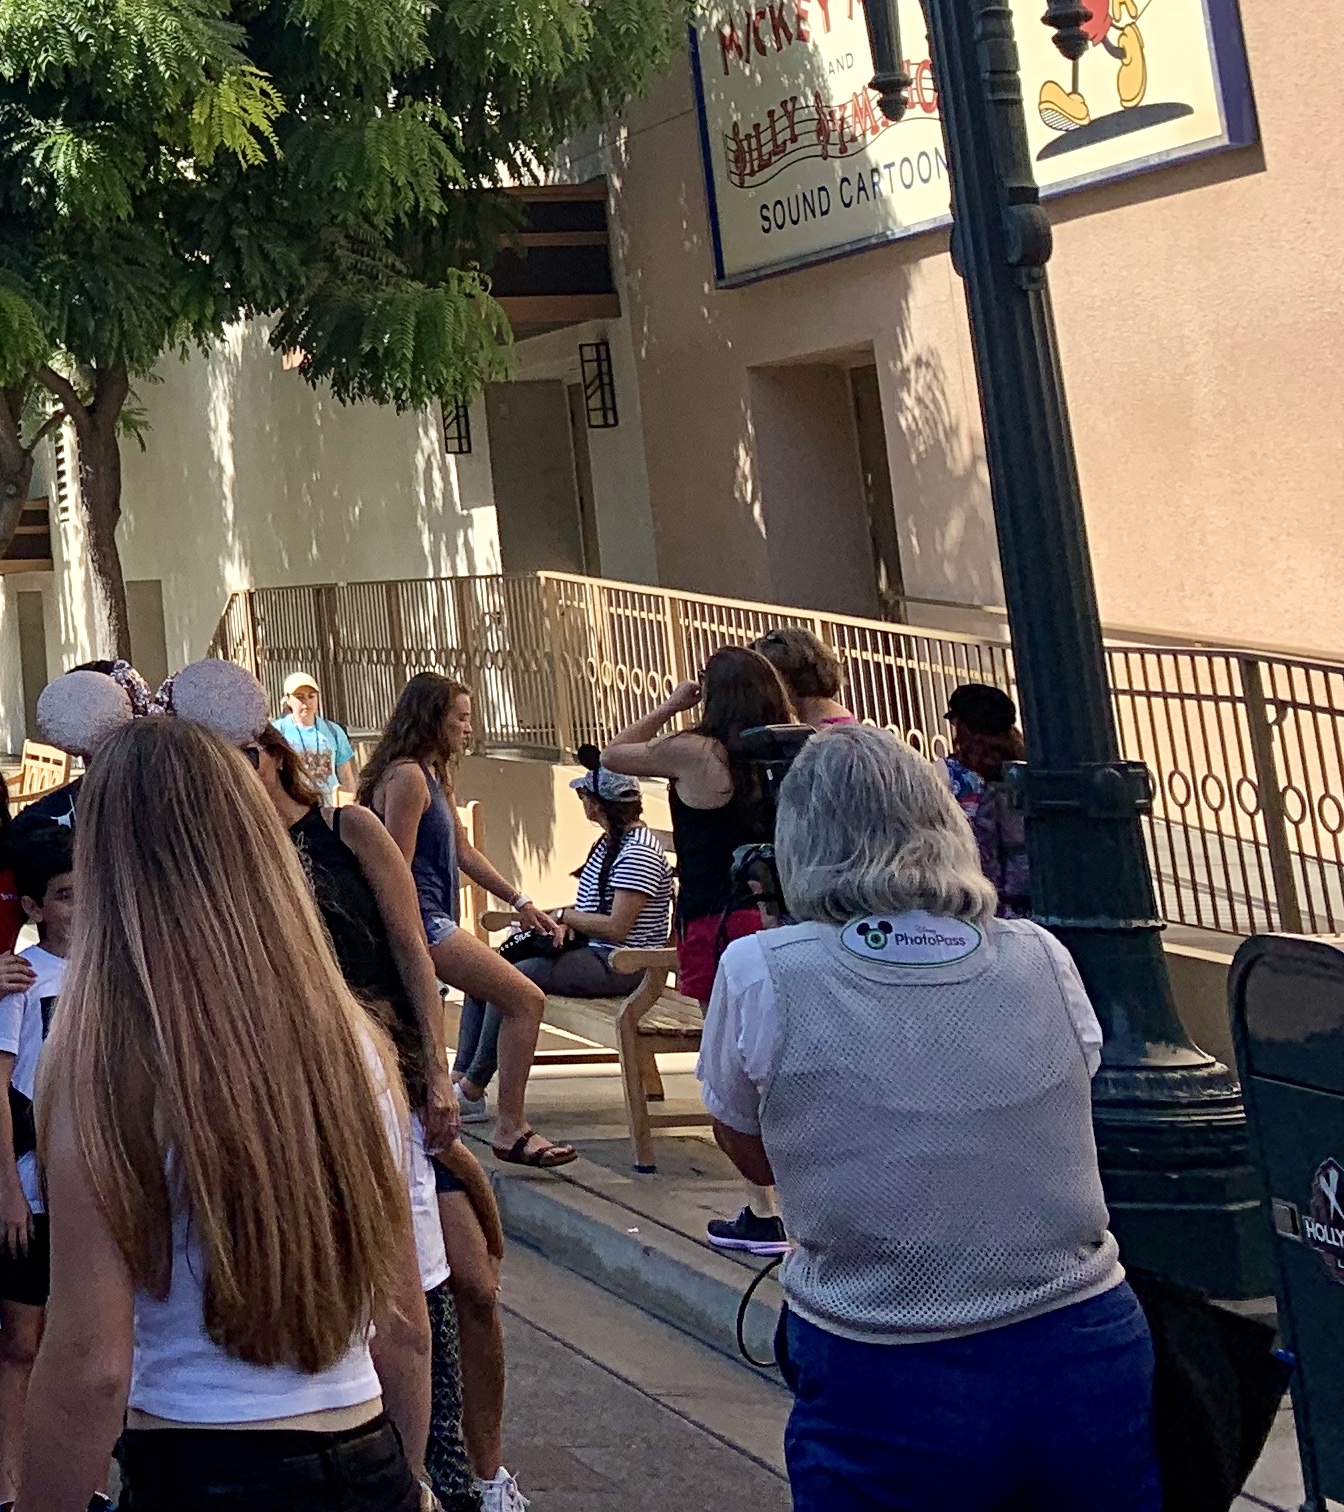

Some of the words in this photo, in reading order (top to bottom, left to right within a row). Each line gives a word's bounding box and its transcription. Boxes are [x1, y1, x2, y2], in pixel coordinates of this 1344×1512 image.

[828, 52, 855, 76] AND
[734, 96, 798, 186] SILLY
[760, 186, 831, 234] SOUND
[894, 932, 967, 947] PhotoPass
